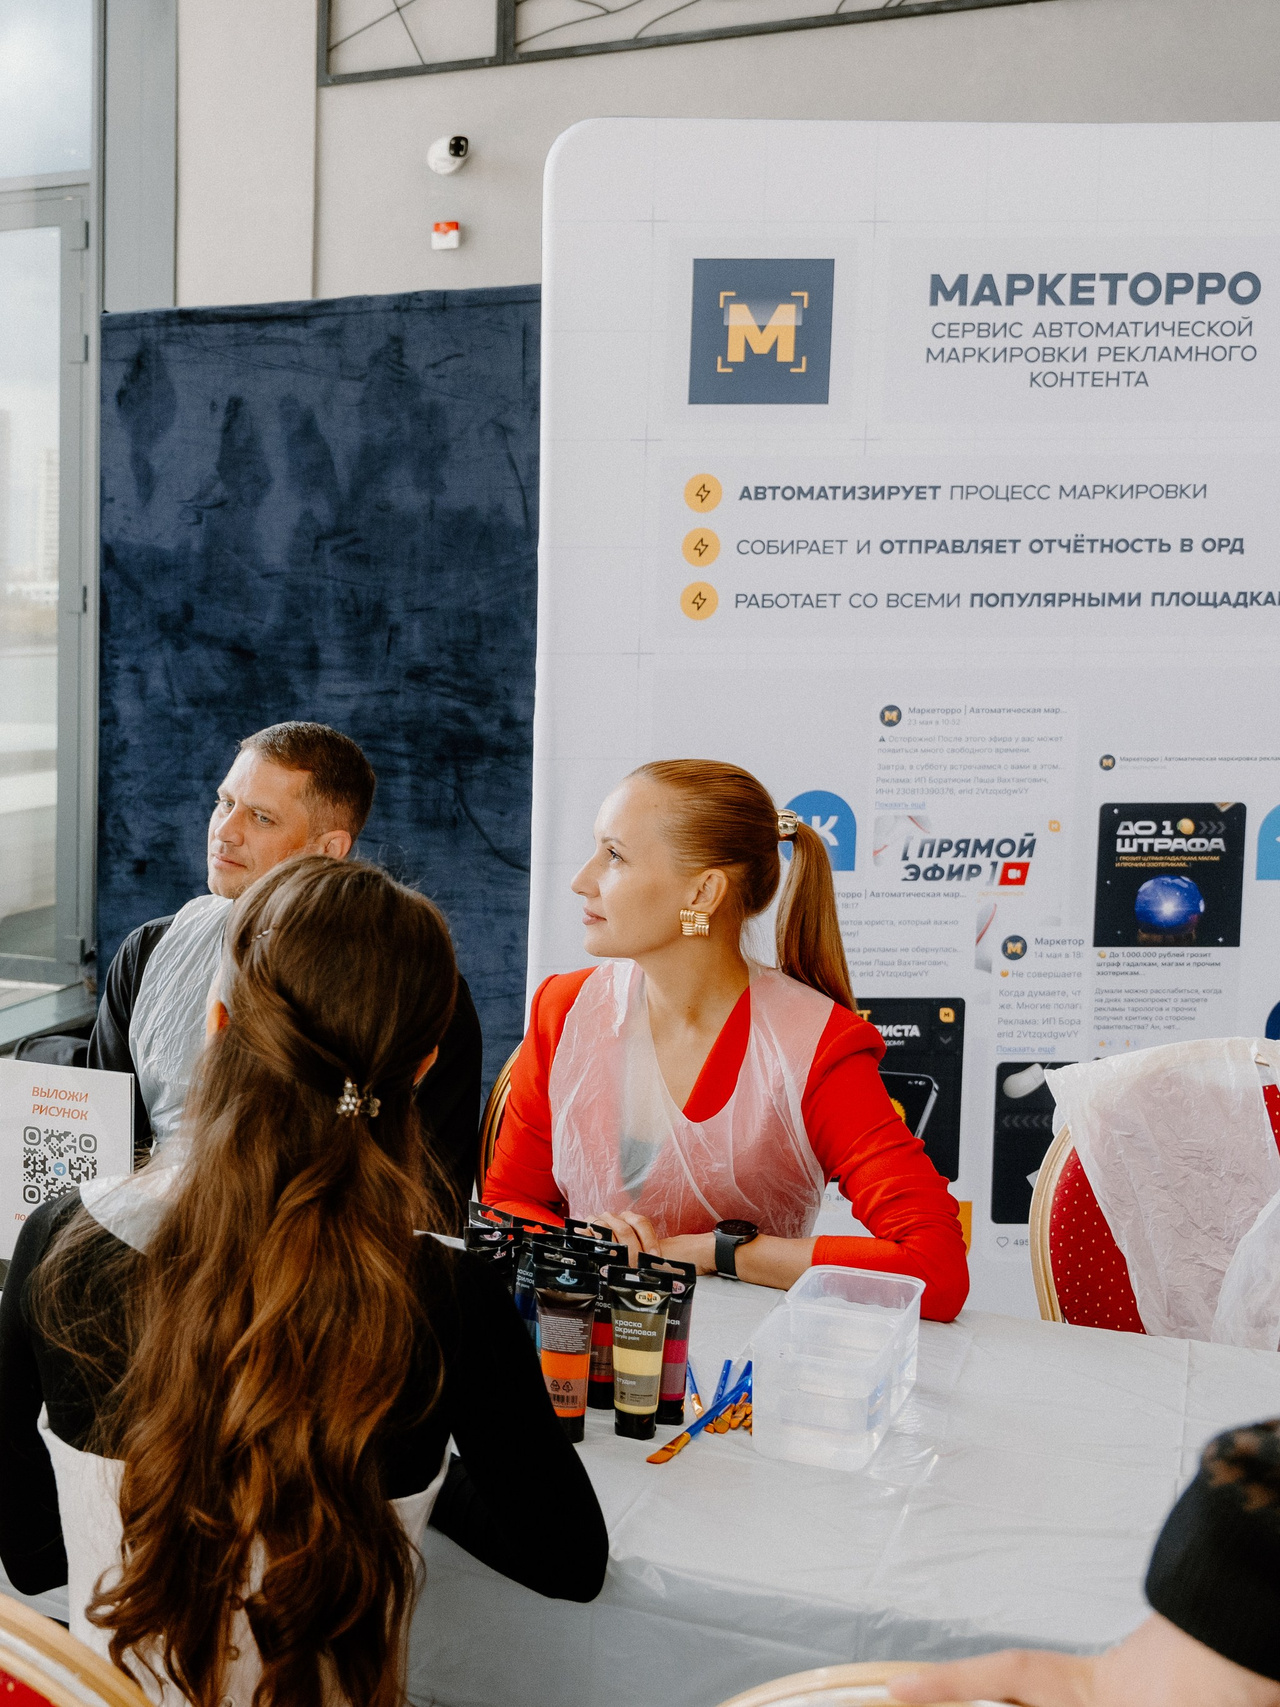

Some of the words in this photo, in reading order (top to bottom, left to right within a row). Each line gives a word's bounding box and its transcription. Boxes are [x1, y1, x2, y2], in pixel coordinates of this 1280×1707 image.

[929, 271, 1263, 307] МАРКЕТОРРО
[932, 321, 1023, 340] СЕРВИС
[1032, 315, 1253, 339] АВТОМАТИЧЕСКОЙ
[925, 346, 1088, 364] МАРКИРОВКИ
[1097, 345, 1258, 363] РЕКЛАМНОГО
[1029, 371, 1150, 389] КОНТЕНТА
[738, 485, 942, 502] АВТОМАТИЗИРУЕТ
[950, 485, 1051, 503] ПРОЦЕСС
[1058, 484, 1208, 501] МАРКИРОВКИ
[736, 539, 848, 556] СОБИРАЕТ
[856, 539, 872, 555] И
[879, 539, 1021, 556] ОТПРАВЛЯЕТ
[1028, 534, 1172, 555] ОТЧЁТНОСТЬ
[1180, 538, 1193, 554] В
[1201, 538, 1245, 557] ОРД
[734, 593, 842, 610] РАБОТАЕТ
[848, 593, 878, 609] СО
[886, 593, 960, 609] ВСЕМИ
[970, 592, 1142, 609] ПОПУЛЯРНЫМИ
[1151, 592, 1280, 612] ПЛОЩАДКА
[908, 707, 962, 715] Маркеторро
[969, 706, 1042, 714] Автоматическая
[946, 746, 993, 754] свободного
[916, 763, 947, 771] субботу
[875, 802, 909, 810] Показать
[1116, 820, 1158, 836] ДО
[1161, 820, 1174, 836] 1
[917, 832, 1037, 859] ПРЯМОЙ
[1116, 837, 1226, 853] ШТРАФА
[901, 863, 982, 882] ЭФИР
[1034, 938, 1084, 946] Маркетор
[996, 1046, 1035, 1054] Показать
[1038, 1046, 1055, 1054] ещё
[32, 1086, 88, 1103] ВЫЛОЖИ
[32, 1104, 88, 1120] РИСУНОК
[615, 1319, 642, 1328] краска
[615, 1326, 657, 1336] акриловая
